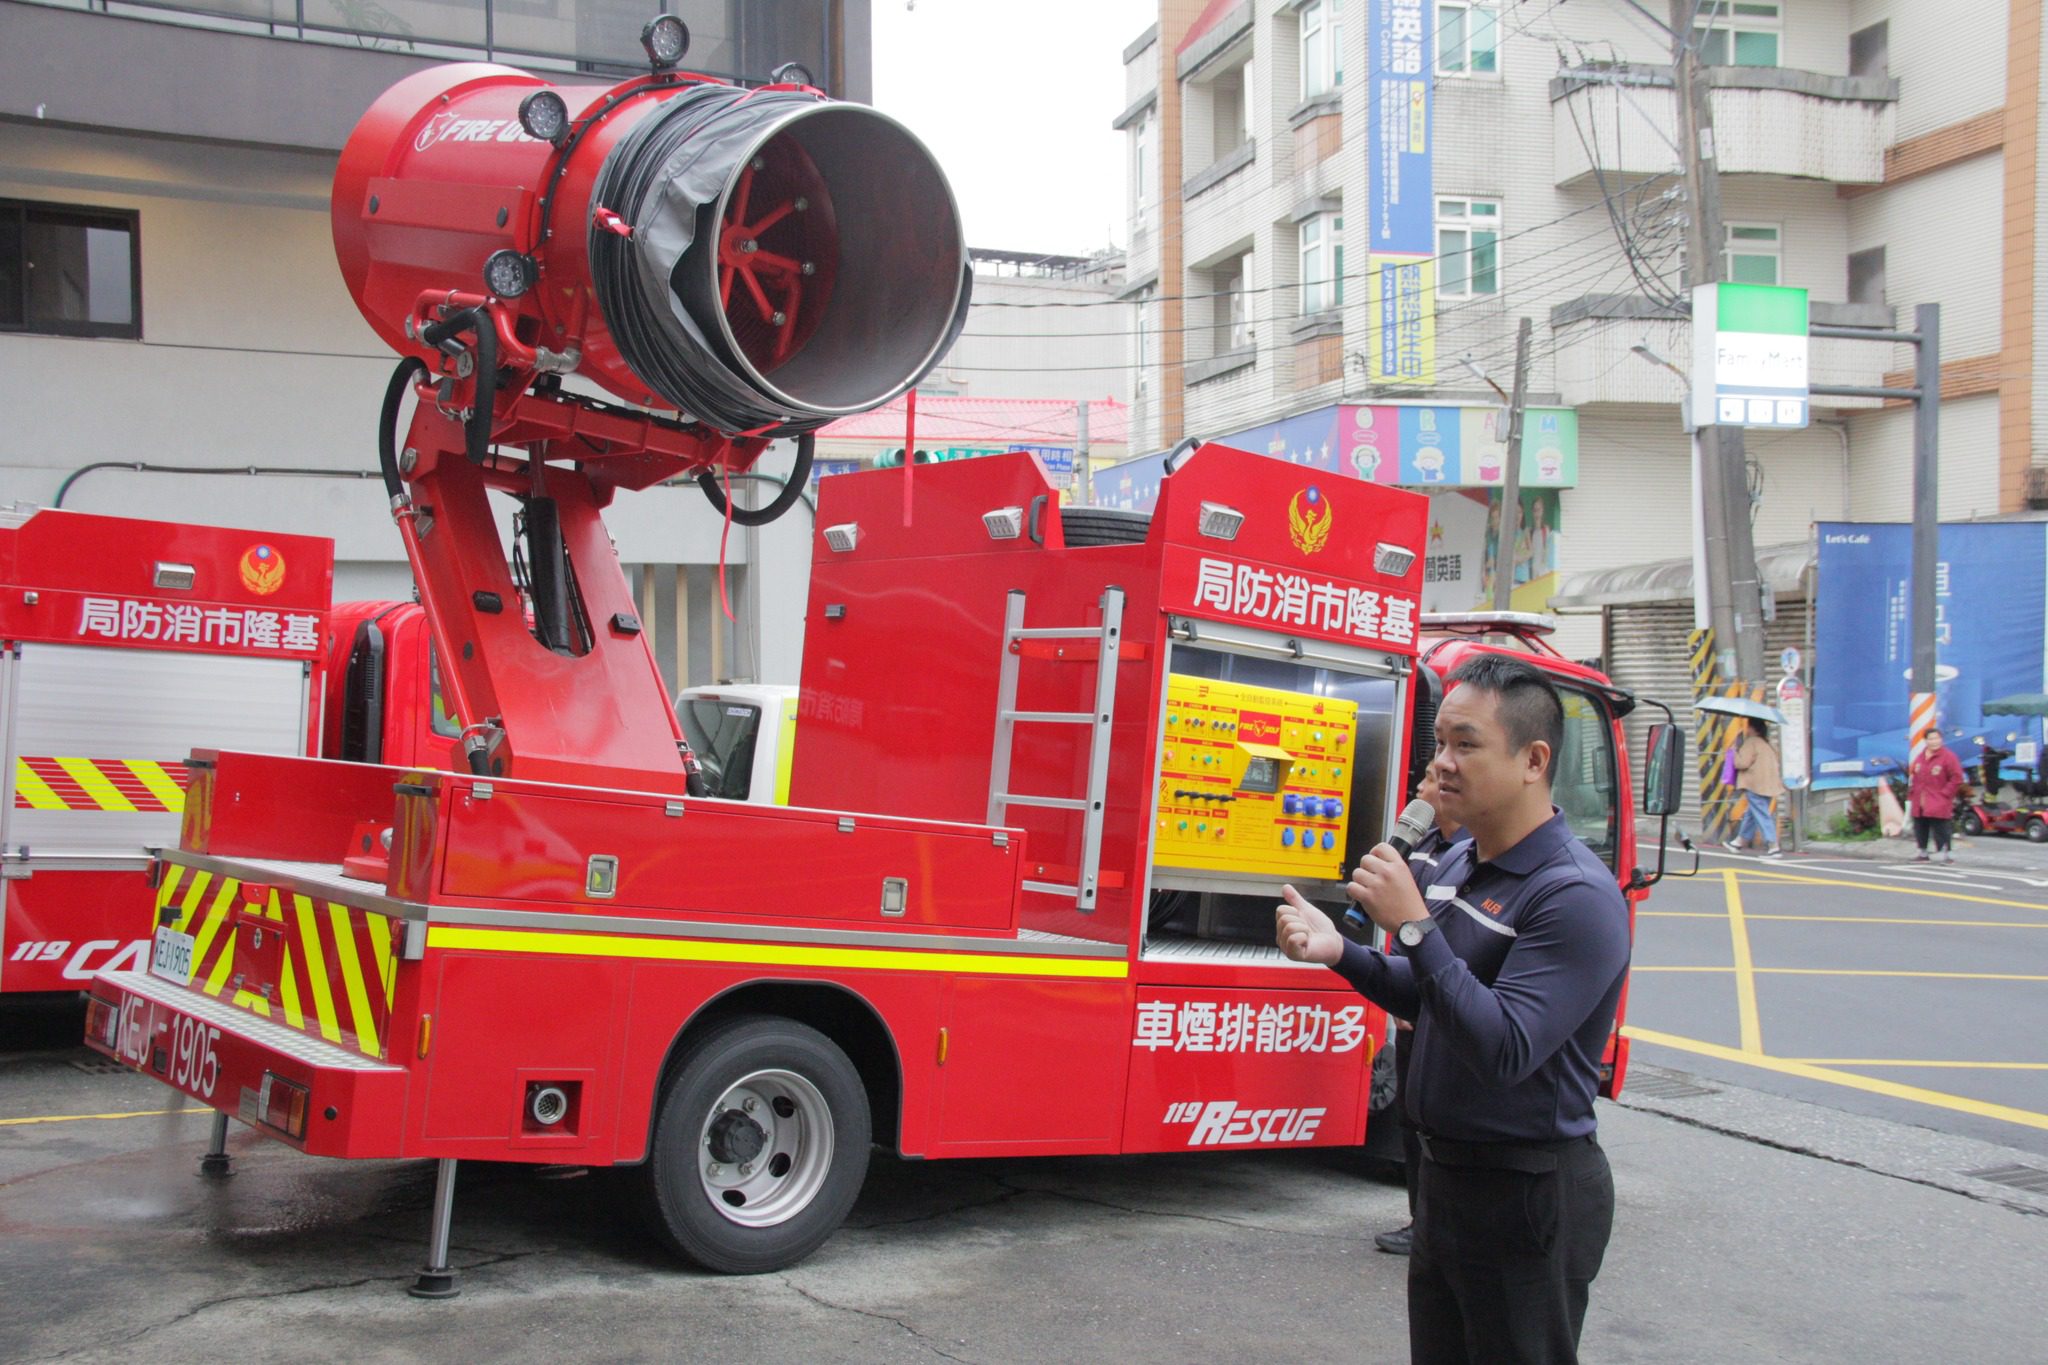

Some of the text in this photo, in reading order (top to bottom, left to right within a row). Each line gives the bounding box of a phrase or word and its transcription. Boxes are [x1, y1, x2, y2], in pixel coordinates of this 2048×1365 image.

[1380, 29, 1391, 73] Center
[1392, 0, 1421, 73] 英語
[440, 119, 499, 142] FIRE
[1402, 264, 1421, 377] 熱烈招生中
[1717, 347, 1803, 369] FamMart
[1420, 409, 1436, 432] R
[1539, 413, 1558, 433] M
[10, 939, 152, 980] 119 CA
[155, 939, 191, 976] KEJ-1905
[1163, 1101, 1204, 1124] 119
